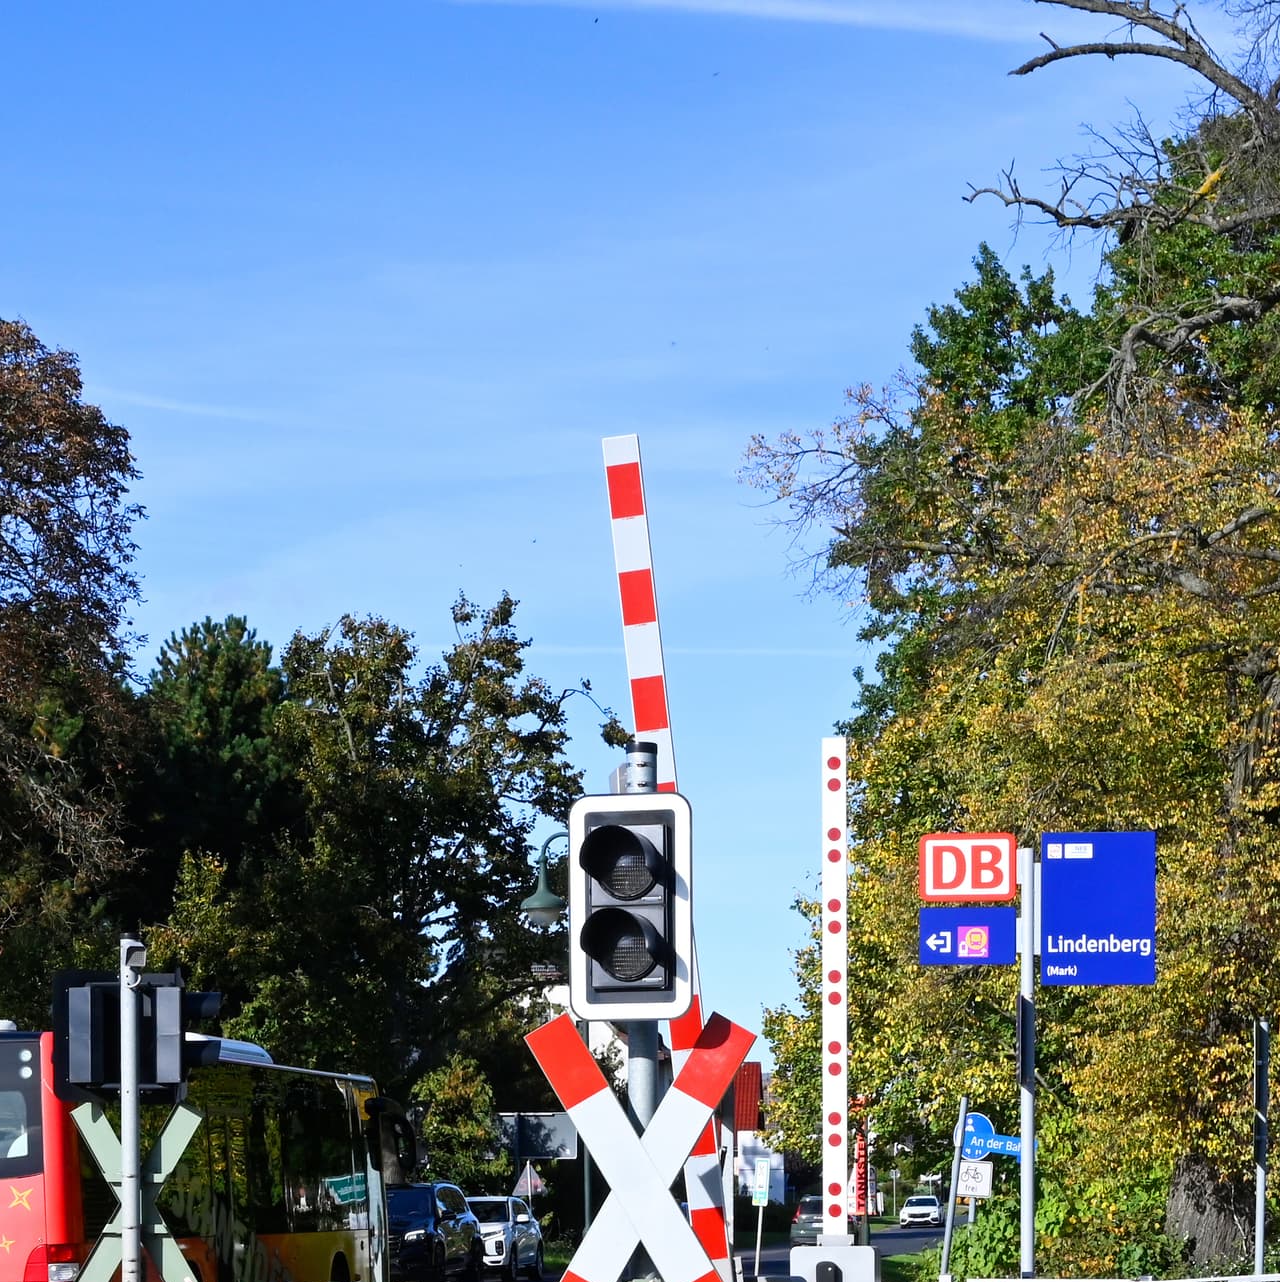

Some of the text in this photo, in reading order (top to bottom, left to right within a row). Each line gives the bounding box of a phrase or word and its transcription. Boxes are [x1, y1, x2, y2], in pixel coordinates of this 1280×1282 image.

[931, 844, 1004, 890] DB
[1046, 933, 1152, 957] Lindenberg
[1046, 965, 1078, 977] (Mark)
[970, 1136, 984, 1147] An
[986, 1138, 1004, 1150] der
